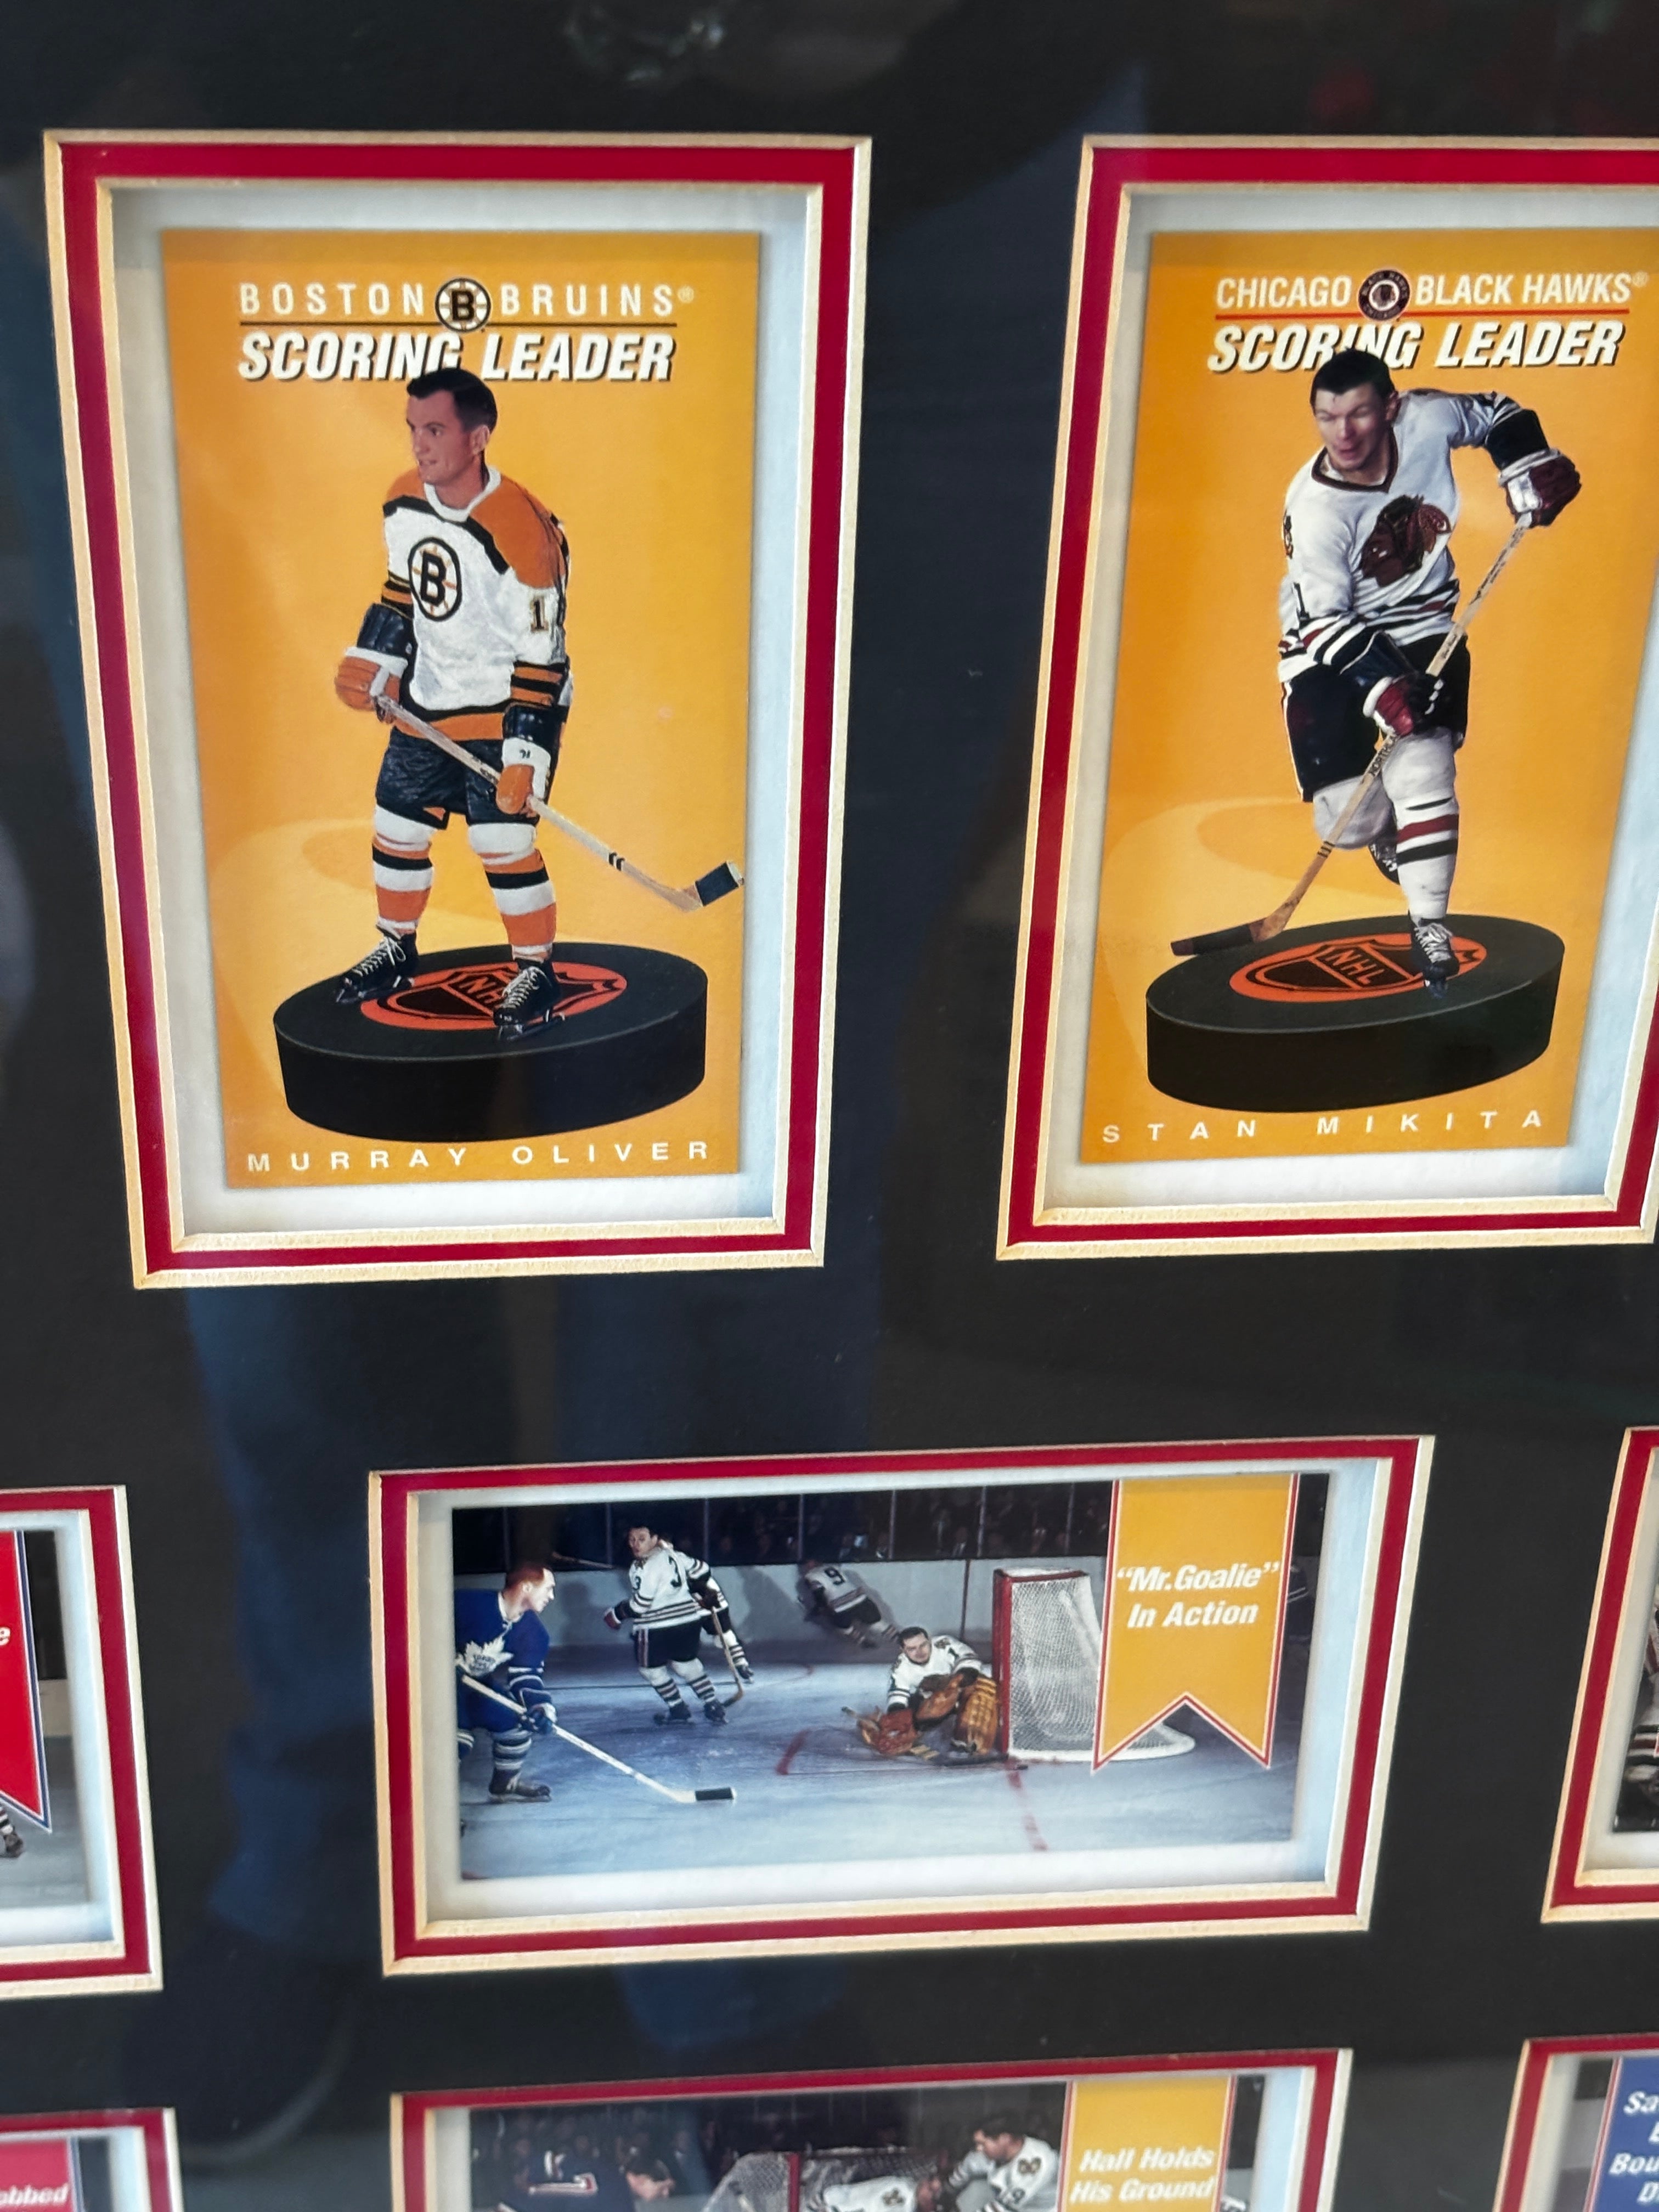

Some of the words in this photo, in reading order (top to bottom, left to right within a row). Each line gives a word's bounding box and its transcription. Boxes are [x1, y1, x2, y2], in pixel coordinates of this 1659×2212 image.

[240, 283, 424, 316] BOSTON
[1217, 275, 1353, 309] CHICAGO
[1415, 274, 1514, 306] BLACK
[238, 331, 462, 381] SCORING
[479, 332, 676, 381] LEADER
[1207, 321, 1423, 371] SCORING
[1434, 320, 1626, 369] LEADER
[1324, 949, 1372, 985] NHL
[1102, 1119, 1256, 1143] STAN
[1317, 1110, 1542, 1135] MIKITA
[247, 1147, 466, 1172] MURRAY
[511, 1141, 708, 1165] OLIVER
[1127, 1603, 1156, 1629] In
[1162, 1600, 1259, 1628] Action
[1079, 2148, 1136, 2173] Hall
[1138, 2146, 1215, 2171] Holds
[1070, 2180, 1113, 2203] His
[1119, 2176, 1216, 2201] Ground
